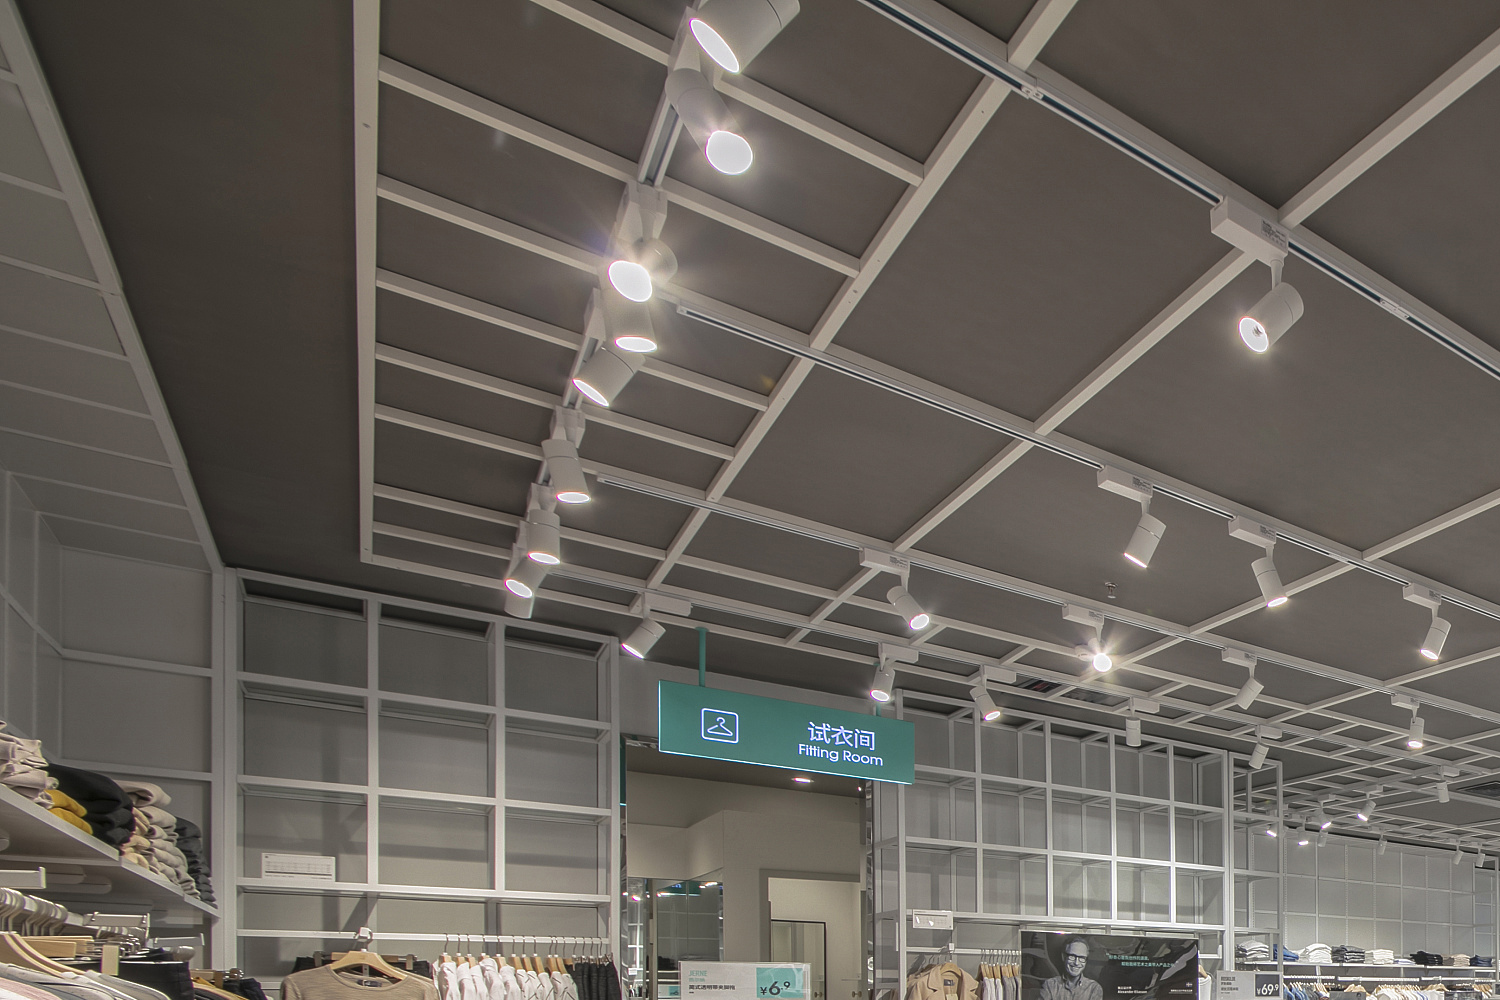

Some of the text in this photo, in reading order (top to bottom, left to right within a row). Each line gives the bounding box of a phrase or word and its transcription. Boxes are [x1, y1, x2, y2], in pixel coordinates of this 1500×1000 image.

[807, 721, 875, 750] 试衣间
[798, 744, 883, 766] Fitting Room
